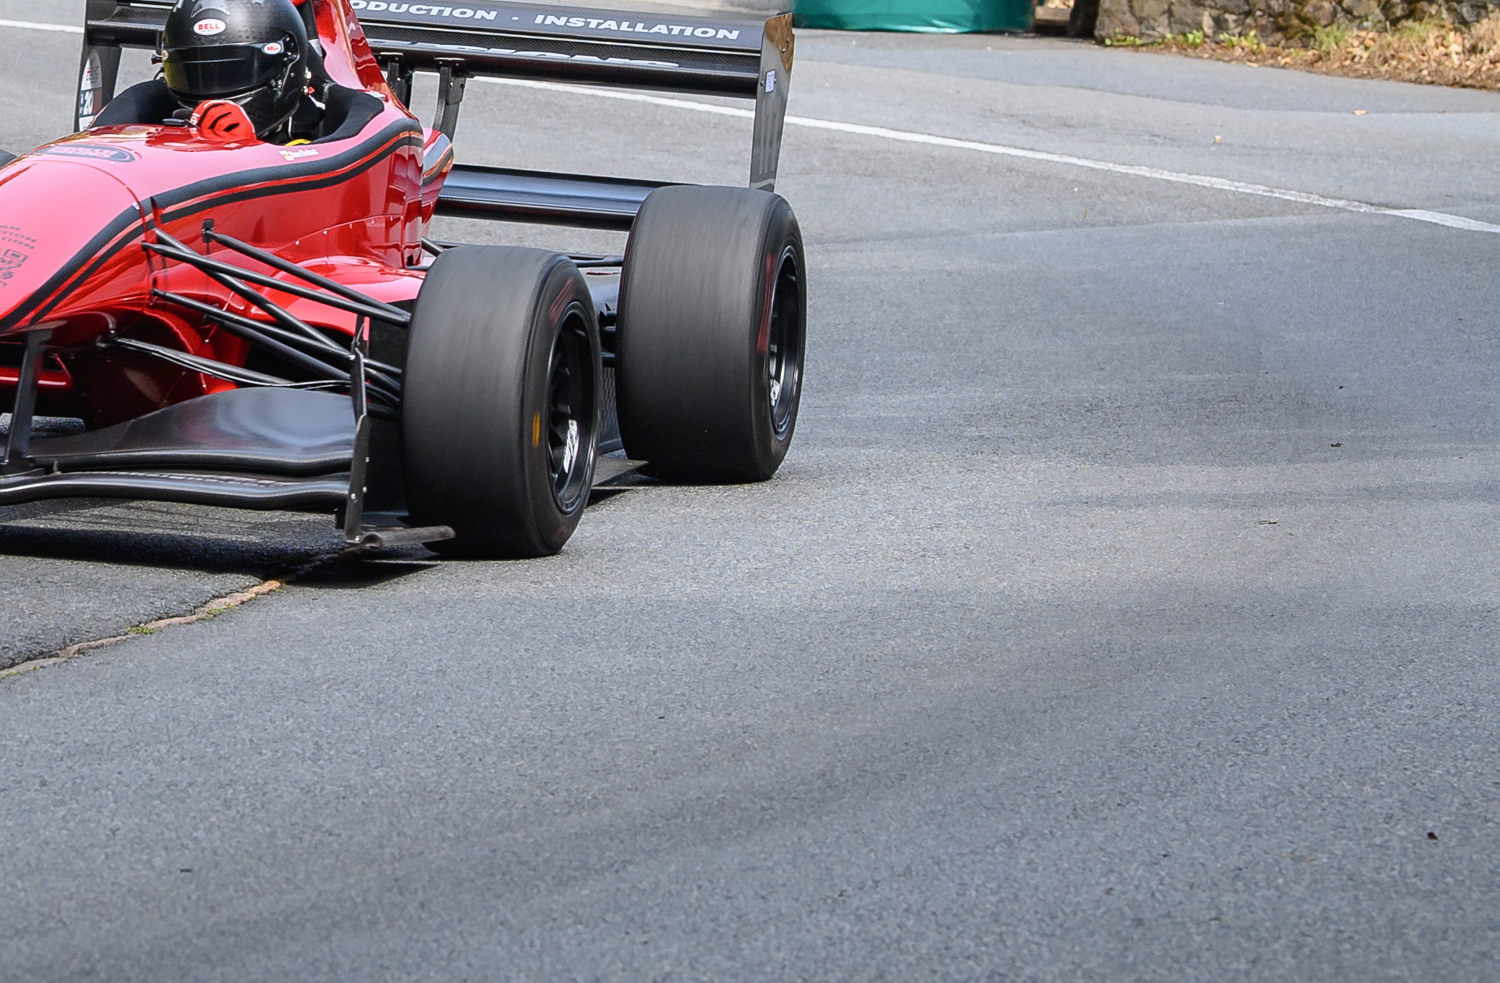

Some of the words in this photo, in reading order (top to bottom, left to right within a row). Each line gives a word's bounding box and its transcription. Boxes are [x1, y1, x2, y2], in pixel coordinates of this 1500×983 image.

[198, 23, 220, 31] BELL
[349, 0, 497, 20] ODUCTION
[534, 14, 740, 41] INSTALLATION
